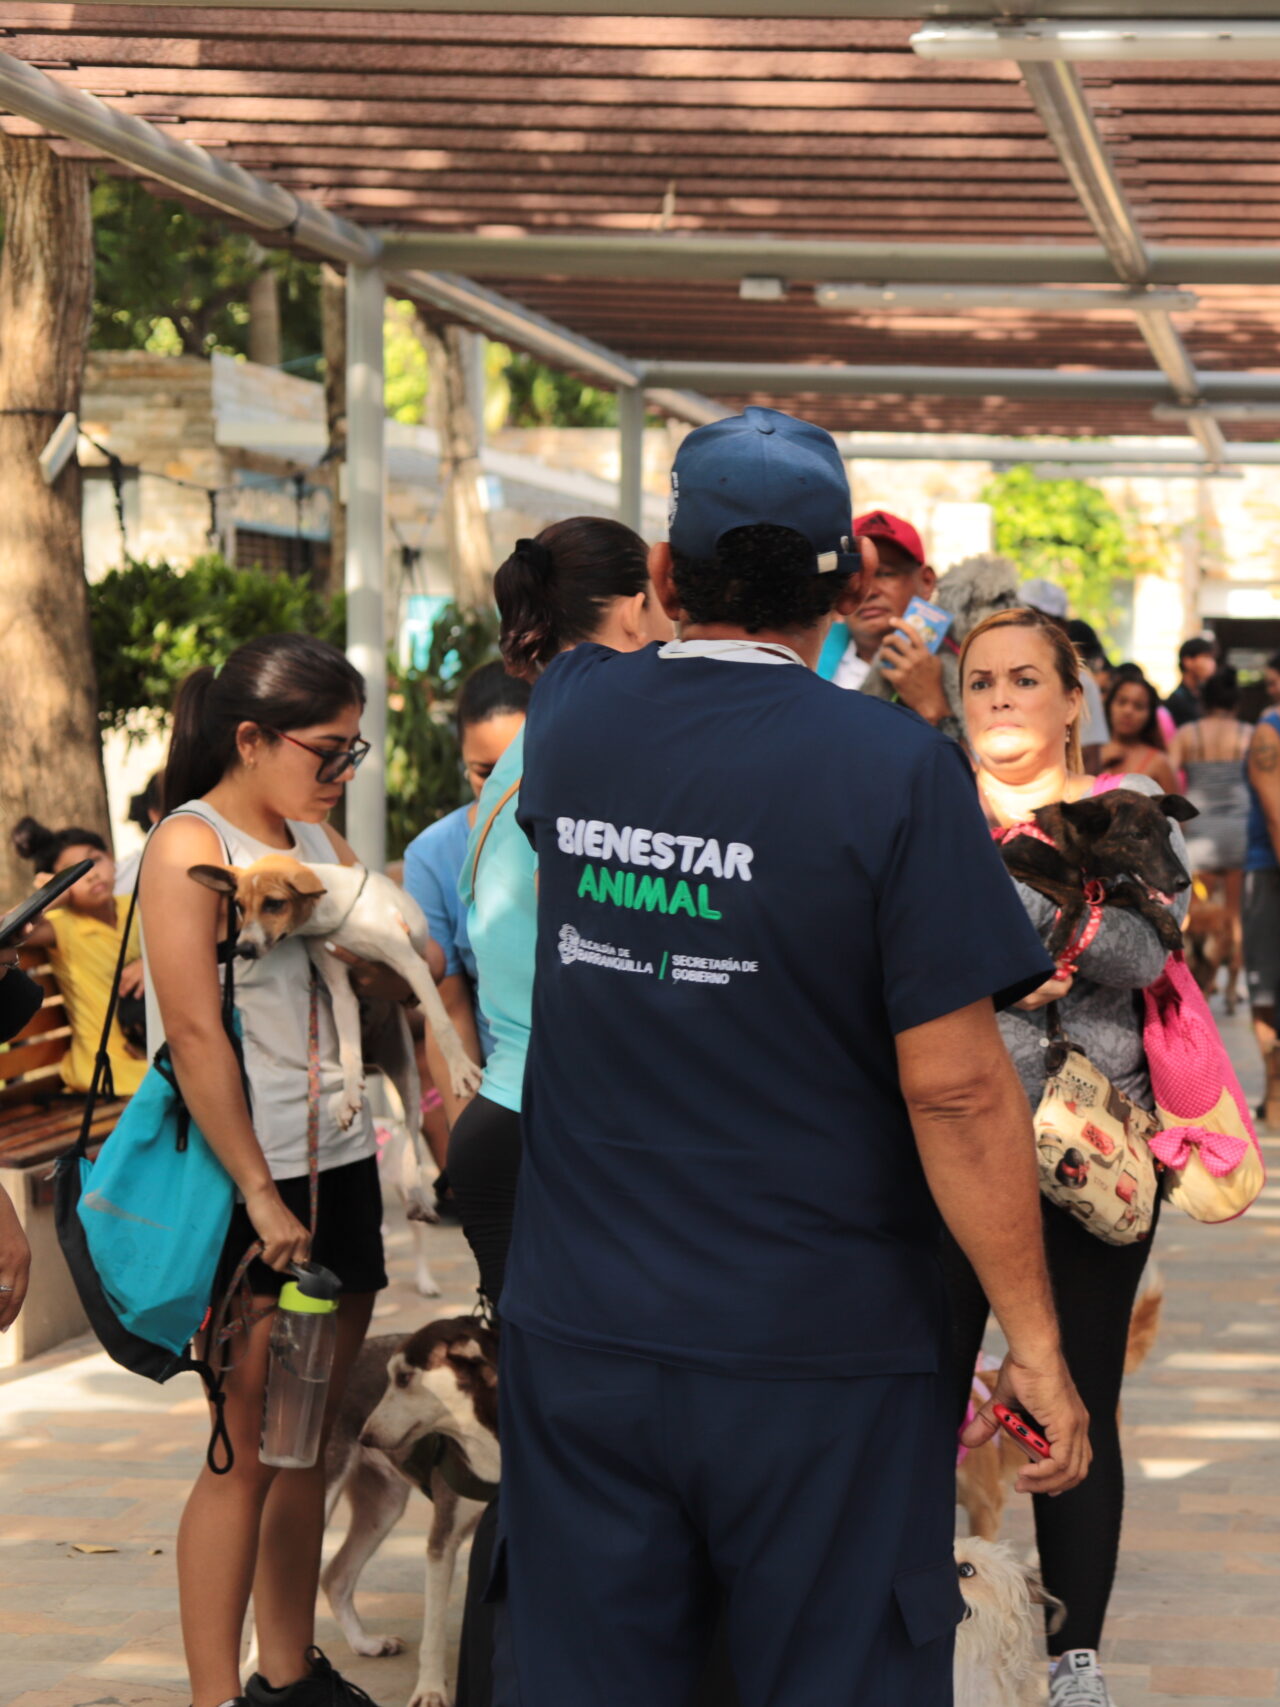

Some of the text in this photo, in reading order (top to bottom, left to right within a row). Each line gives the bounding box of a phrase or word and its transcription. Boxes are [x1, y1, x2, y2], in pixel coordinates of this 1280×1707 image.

[556, 816, 754, 881] BIENESTAR
[577, 863, 722, 920] ANIMAL
[617, 947, 631, 958] DE
[741, 960, 759, 972] DE
[671, 968, 729, 985] GOBIERNO
